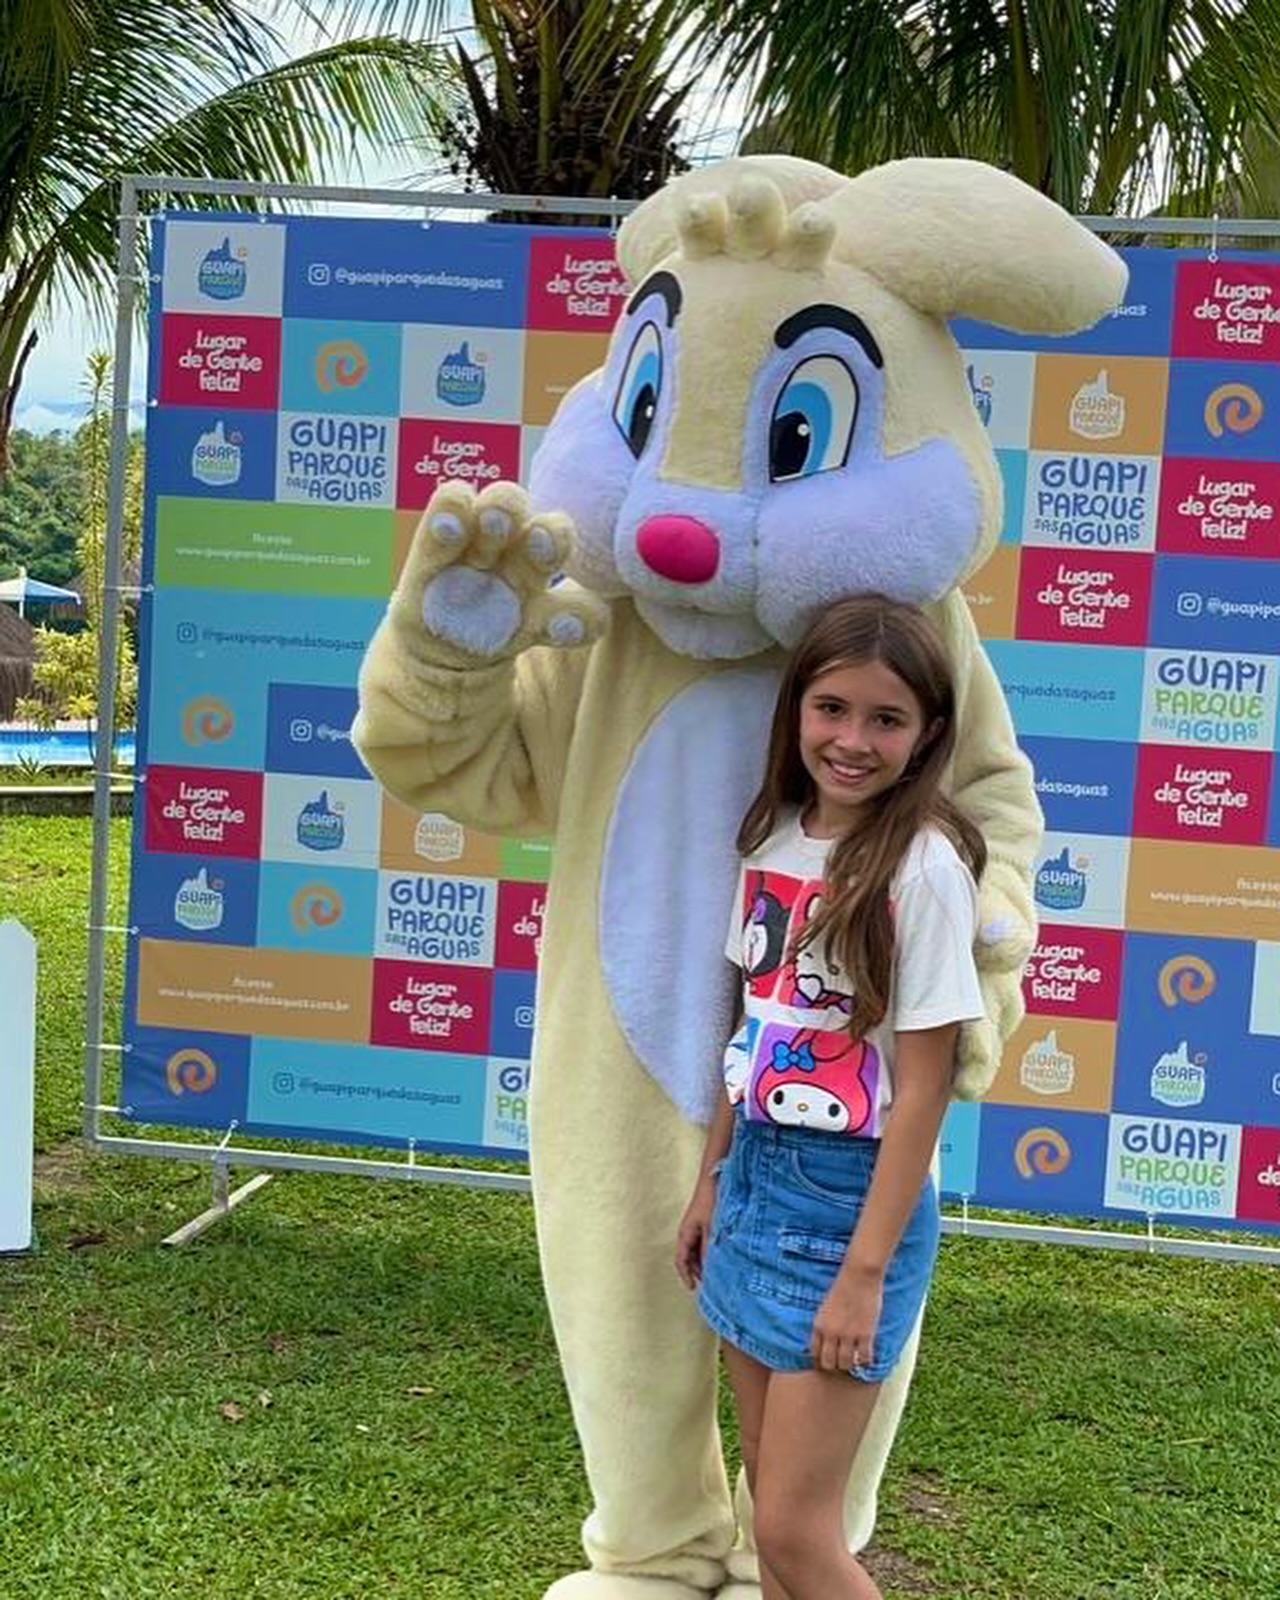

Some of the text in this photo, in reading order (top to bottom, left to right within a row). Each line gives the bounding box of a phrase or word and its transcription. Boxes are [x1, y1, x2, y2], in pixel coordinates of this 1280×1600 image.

[565, 254, 617, 277] Lugar
[546, 273, 634, 295] de Gente
[1214, 278, 1272, 302] Lugar
[1193, 298, 1221, 319] de
[196, 330, 247, 351] Lugar
[179, 350, 262, 371] de Gente
[290, 418, 386, 453] GUAPI
[433, 435, 485, 458] Lugar
[288, 450, 386, 479] PARQUE
[414, 455, 501, 478] de Gente
[1041, 457, 1147, 494] GUAPI
[1198, 476, 1256, 500] Lugar
[1038, 491, 1146, 520] PARQUE
[1178, 495, 1273, 519] de Gente
[1057, 565, 1114, 588] Lugar
[1037, 584, 1130, 608] de Gente
[1158, 654, 1265, 693] GUAPI
[1155, 689, 1264, 719] PARQUE
[1174, 764, 1232, 787] Lugar
[180, 782, 229, 803] Lugar
[1154, 782, 1248, 807] de Gente
[163, 800, 245, 823] de Gente
[1039, 870, 1083, 886] GUAPI
[390, 877, 485, 914] GUAPI
[388, 907, 484, 938] PARQUE
[513, 917, 538, 935] de
[1033, 945, 1084, 961] ugar
[1040, 961, 1101, 983] Gente
[406, 977, 458, 999] Lugar
[389, 995, 473, 1019] de Gente
[1122, 1123, 1226, 1162] GUAPI
[1120, 1155, 1225, 1187] PARQUE
